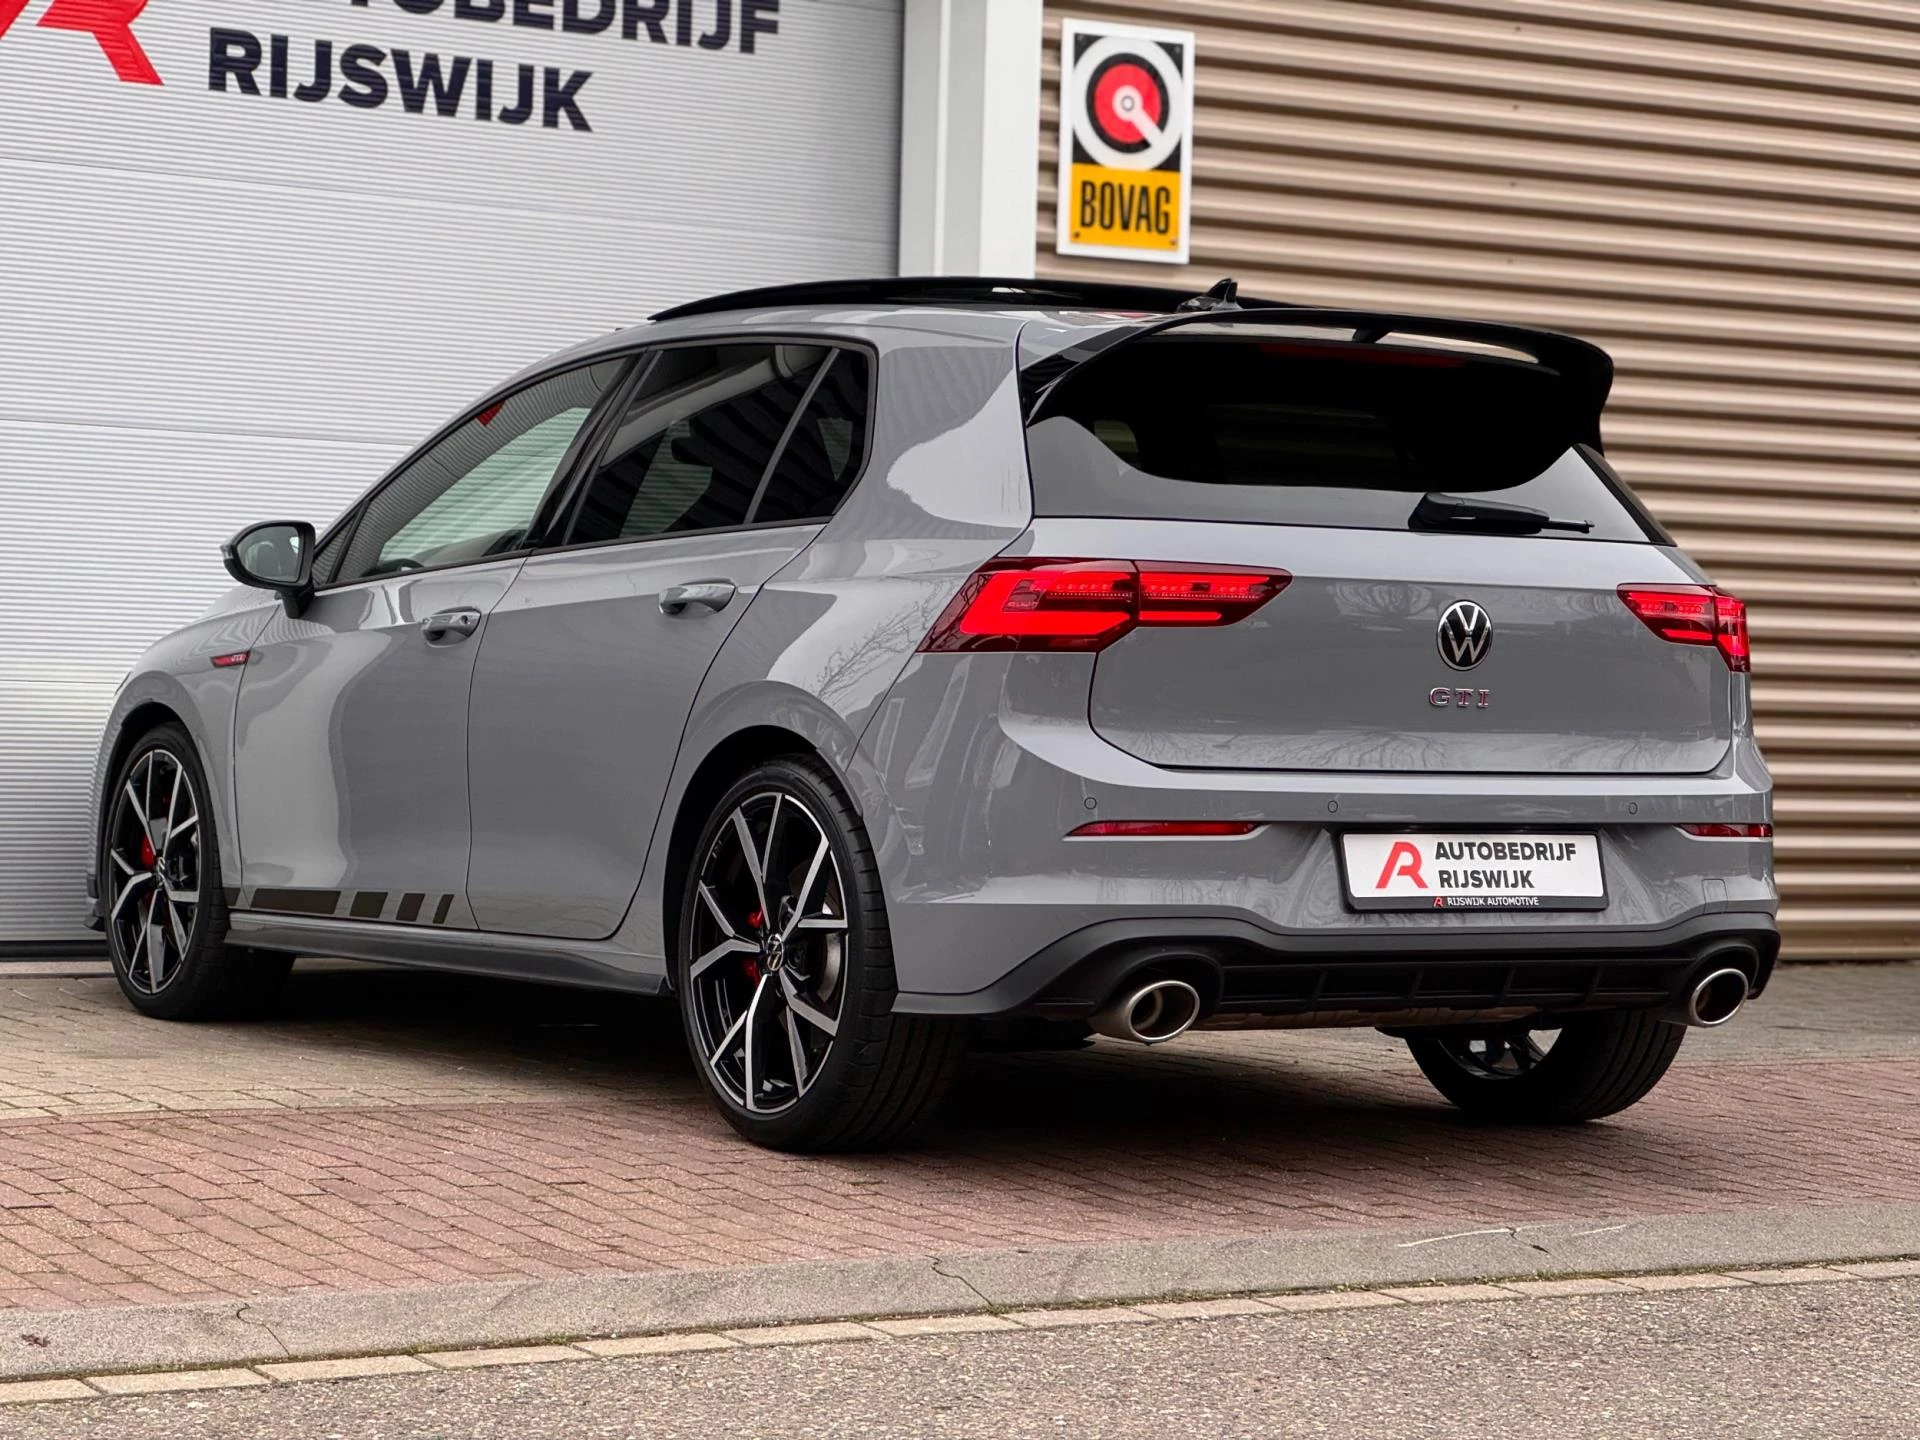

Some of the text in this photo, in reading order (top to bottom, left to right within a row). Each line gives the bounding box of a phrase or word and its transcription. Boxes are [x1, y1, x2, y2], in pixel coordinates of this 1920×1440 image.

[208, 27, 594, 133] RIJSWIJK
[1080, 180, 1170, 235] BOVAG
[1429, 687, 1490, 708] GTI
[1435, 841, 1577, 861] AUTOBEDRIJF
[1438, 870, 1535, 889] RIJSWIJK
[1447, 897, 1485, 906] RIJSWIJK
[1487, 897, 1540, 906] AUTOMOTIVE
